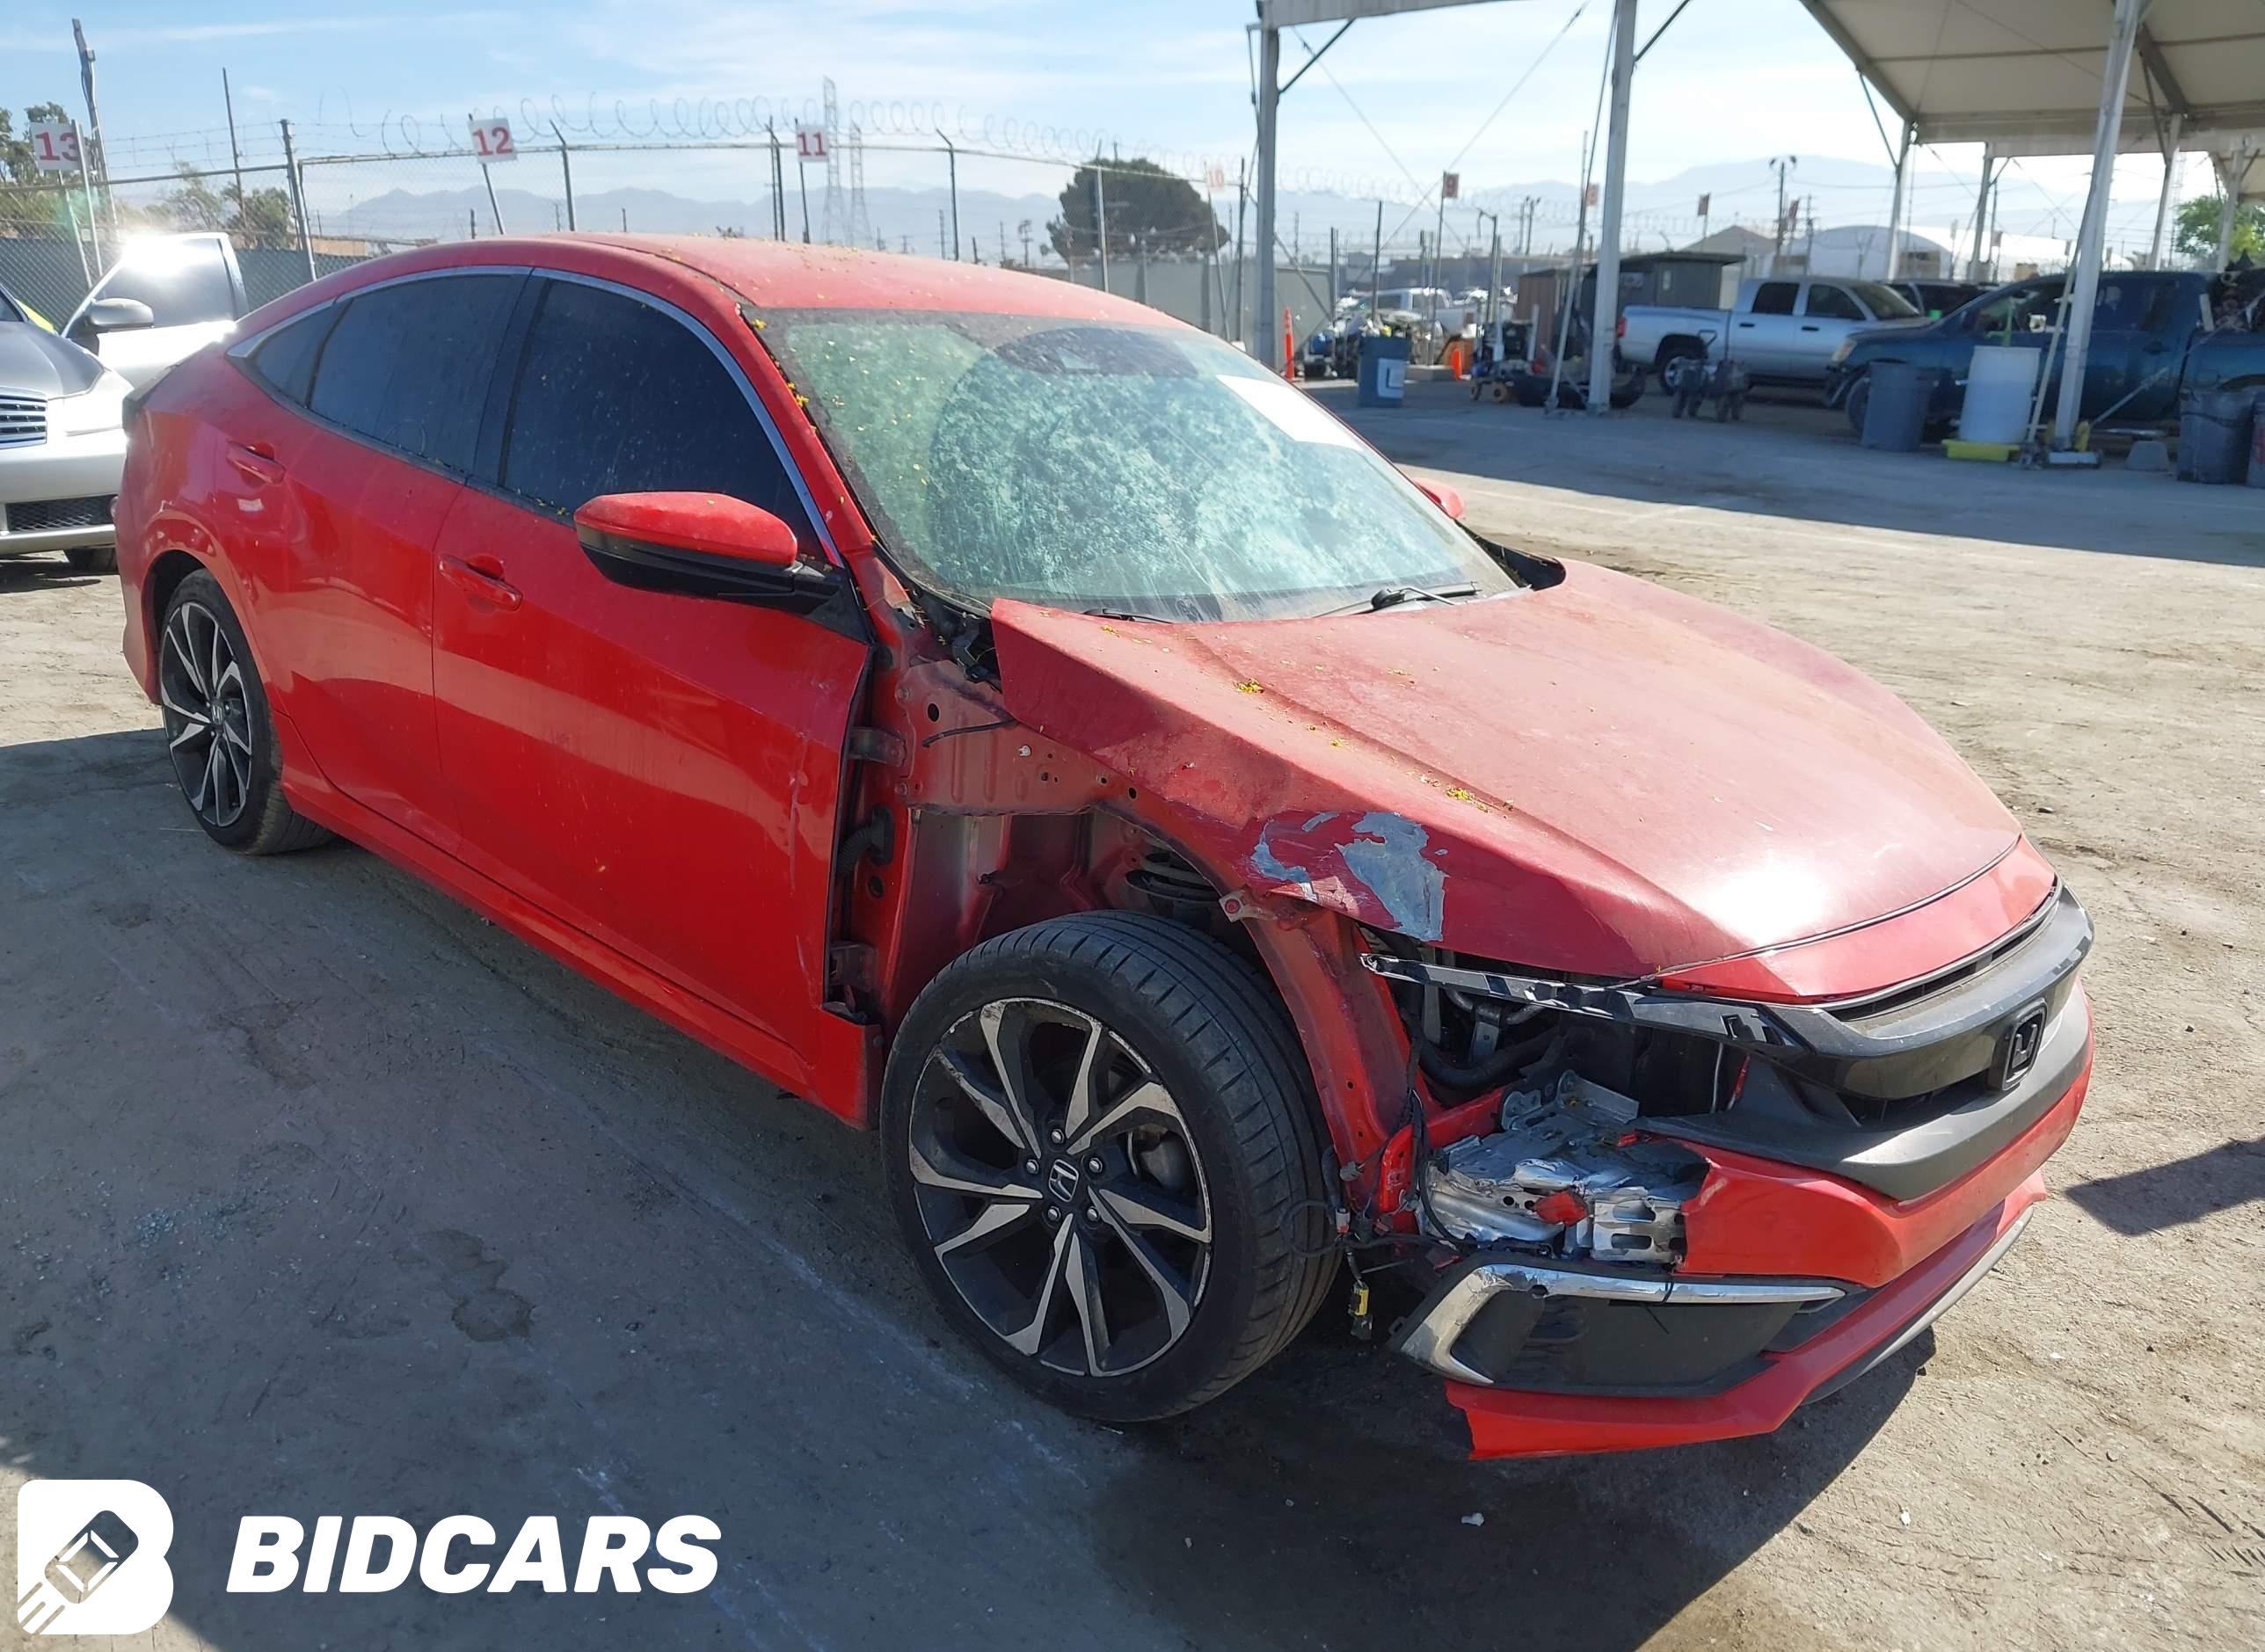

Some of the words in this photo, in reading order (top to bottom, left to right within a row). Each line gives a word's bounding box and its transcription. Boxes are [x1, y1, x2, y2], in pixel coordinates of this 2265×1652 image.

[35, 131, 79, 161] 13
[472, 127, 513, 156] 12
[797, 132, 827, 156] 11
